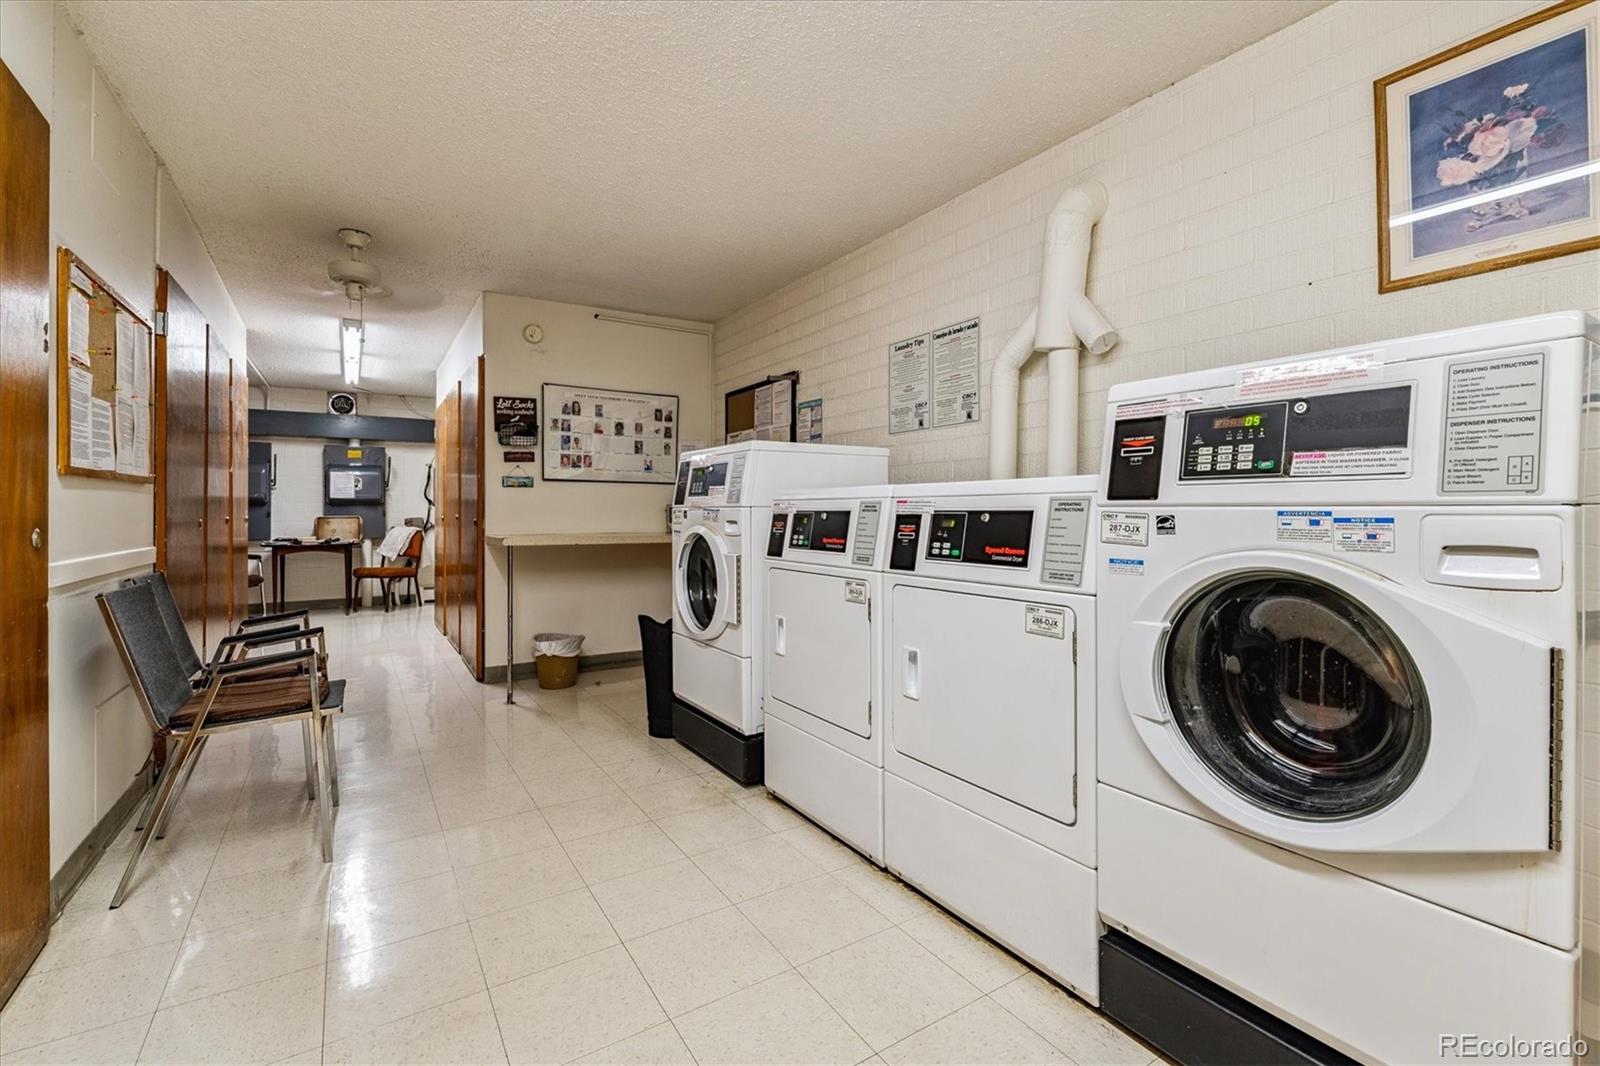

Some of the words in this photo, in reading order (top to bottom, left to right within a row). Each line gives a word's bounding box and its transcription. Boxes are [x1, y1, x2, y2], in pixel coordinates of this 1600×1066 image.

[894, 343, 913, 352] Laundry
[914, 338, 924, 346] Tips
[1453, 366, 1488, 374] OPERATING
[1490, 360, 1538, 370] INSTRUCTIONS
[512, 400, 534, 408] Socks
[1487, 416, 1536, 424] INSTRUCTIONS
[1109, 524, 1140, 533] 287-DJX
[985, 546, 1004, 554] Speed
[1032, 616, 1058, 627] 286-DJX
